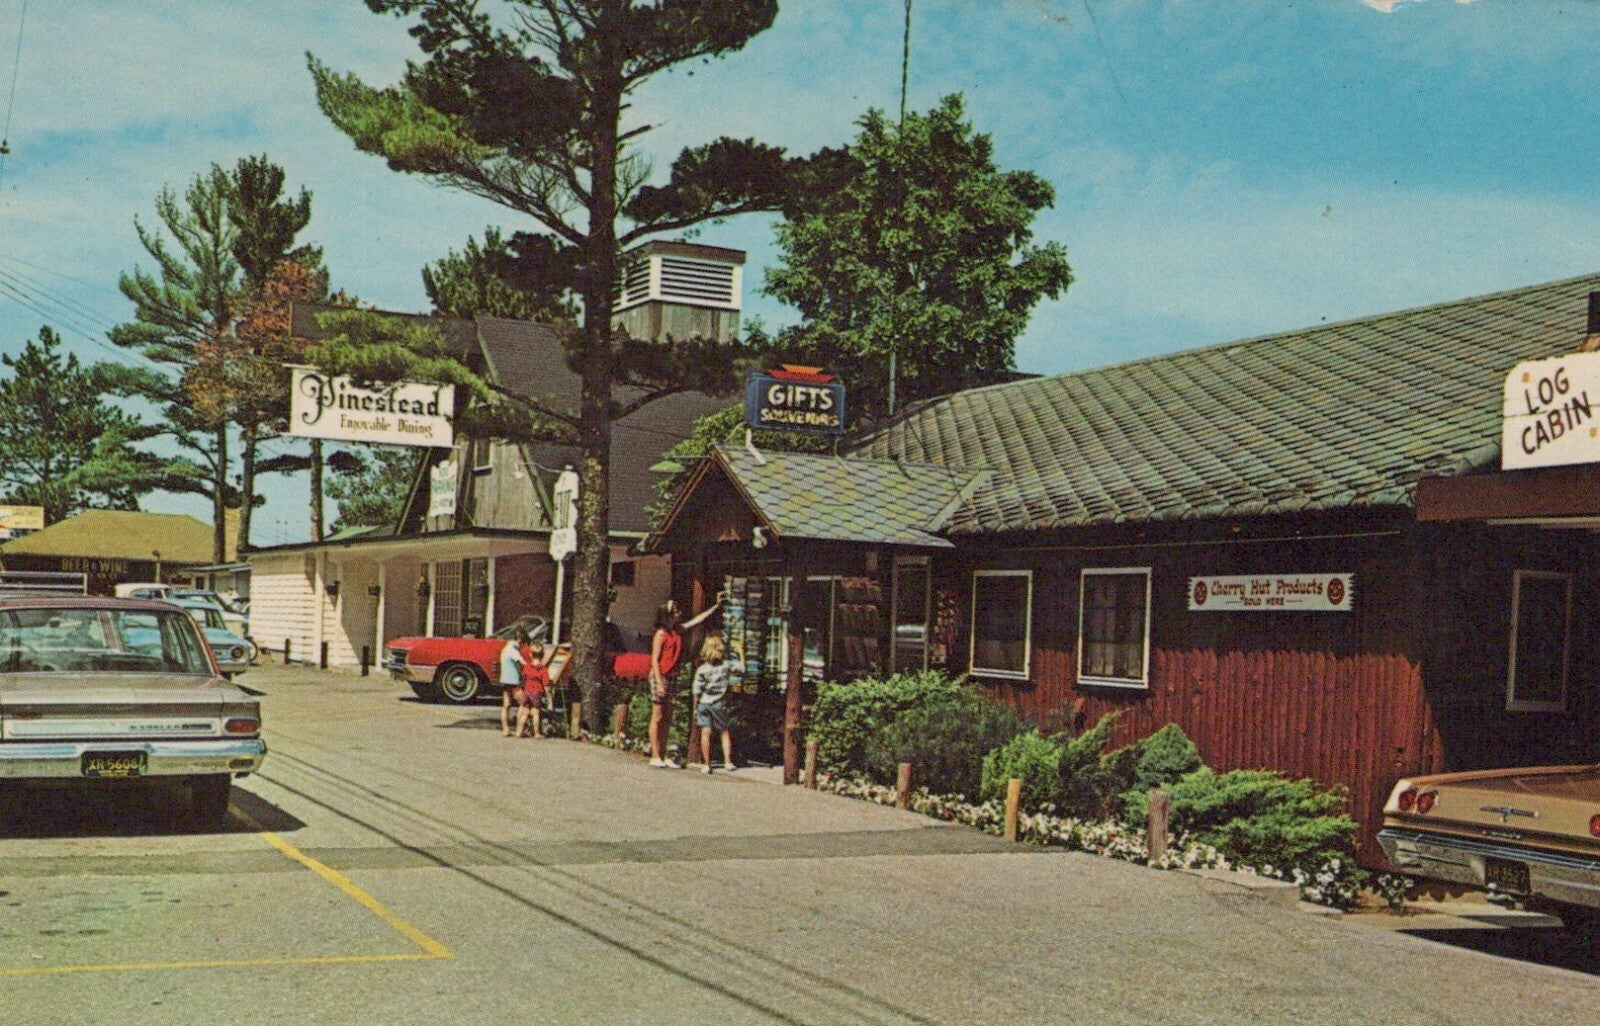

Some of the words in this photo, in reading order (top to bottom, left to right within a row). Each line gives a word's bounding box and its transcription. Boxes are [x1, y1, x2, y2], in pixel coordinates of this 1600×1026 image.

[301, 374, 440, 425] Pinestead
[768, 384, 834, 410] GIFTS
[1525, 367, 1569, 415] LOG
[341, 413, 391, 433] Enjoyable
[398, 419, 433, 438] Dining
[1522, 391, 1591, 455] CABIN
[1211, 580, 1245, 599] Cherry
[1251, 579, 1271, 595] Hut
[1276, 579, 1323, 595] Products
[1266, 597, 1285, 606] HERE
